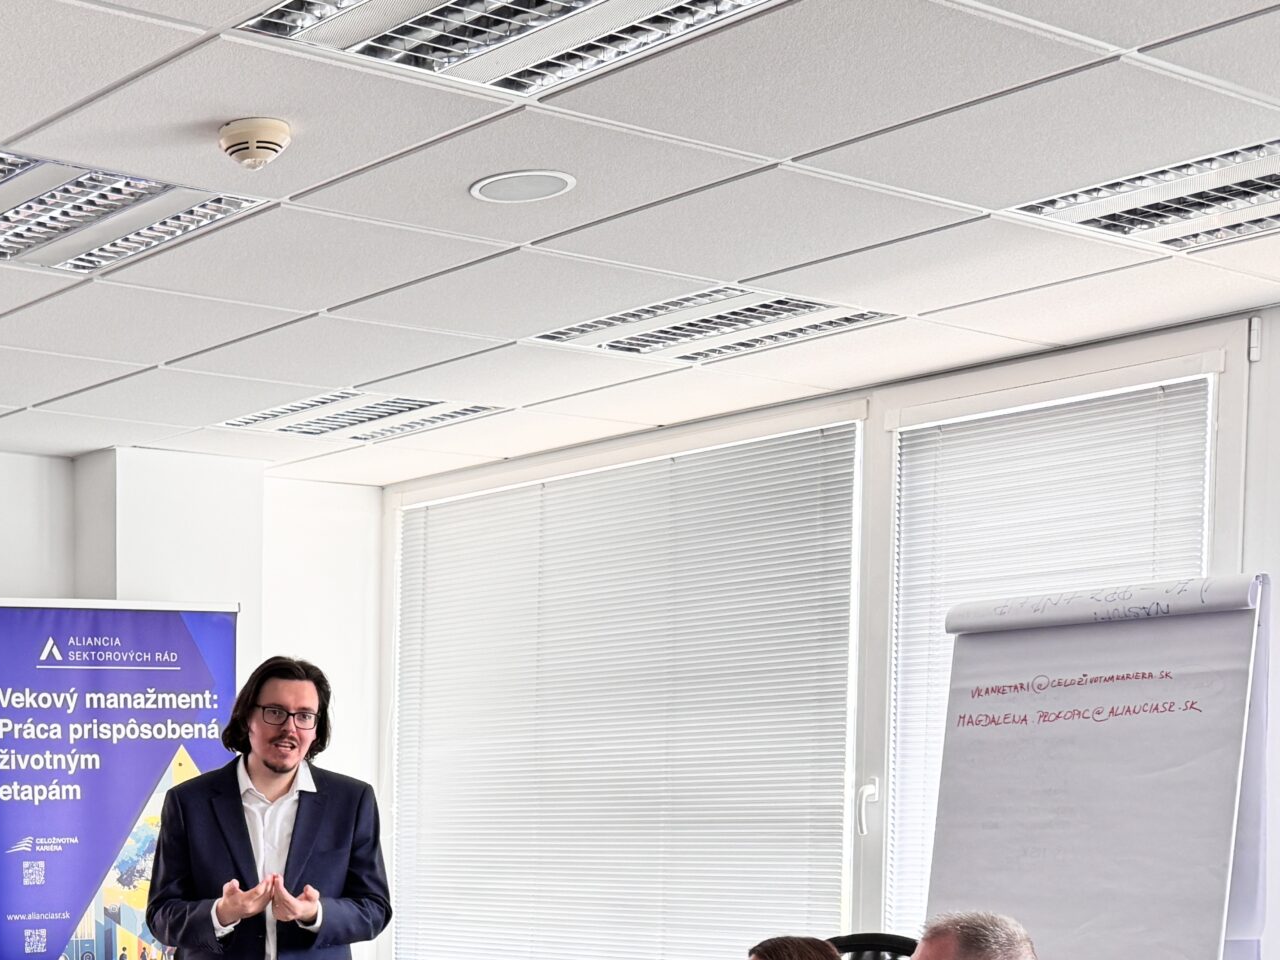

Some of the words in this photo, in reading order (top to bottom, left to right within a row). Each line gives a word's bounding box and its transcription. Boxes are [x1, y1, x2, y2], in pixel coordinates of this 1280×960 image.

[68, 636, 121, 647] ALIANCIA
[68, 649, 151, 662] SEKTOROVÝCH
[155, 649, 178, 662] RÁD
[85, 688, 219, 709] manažment:
[69, 718, 220, 744] prispôsobená
[35, 836, 79, 845] CELOŽIVOTNÁ
[35, 844, 63, 852] KARIÉRA
[6, 911, 71, 922] www.alianciasr.sk
